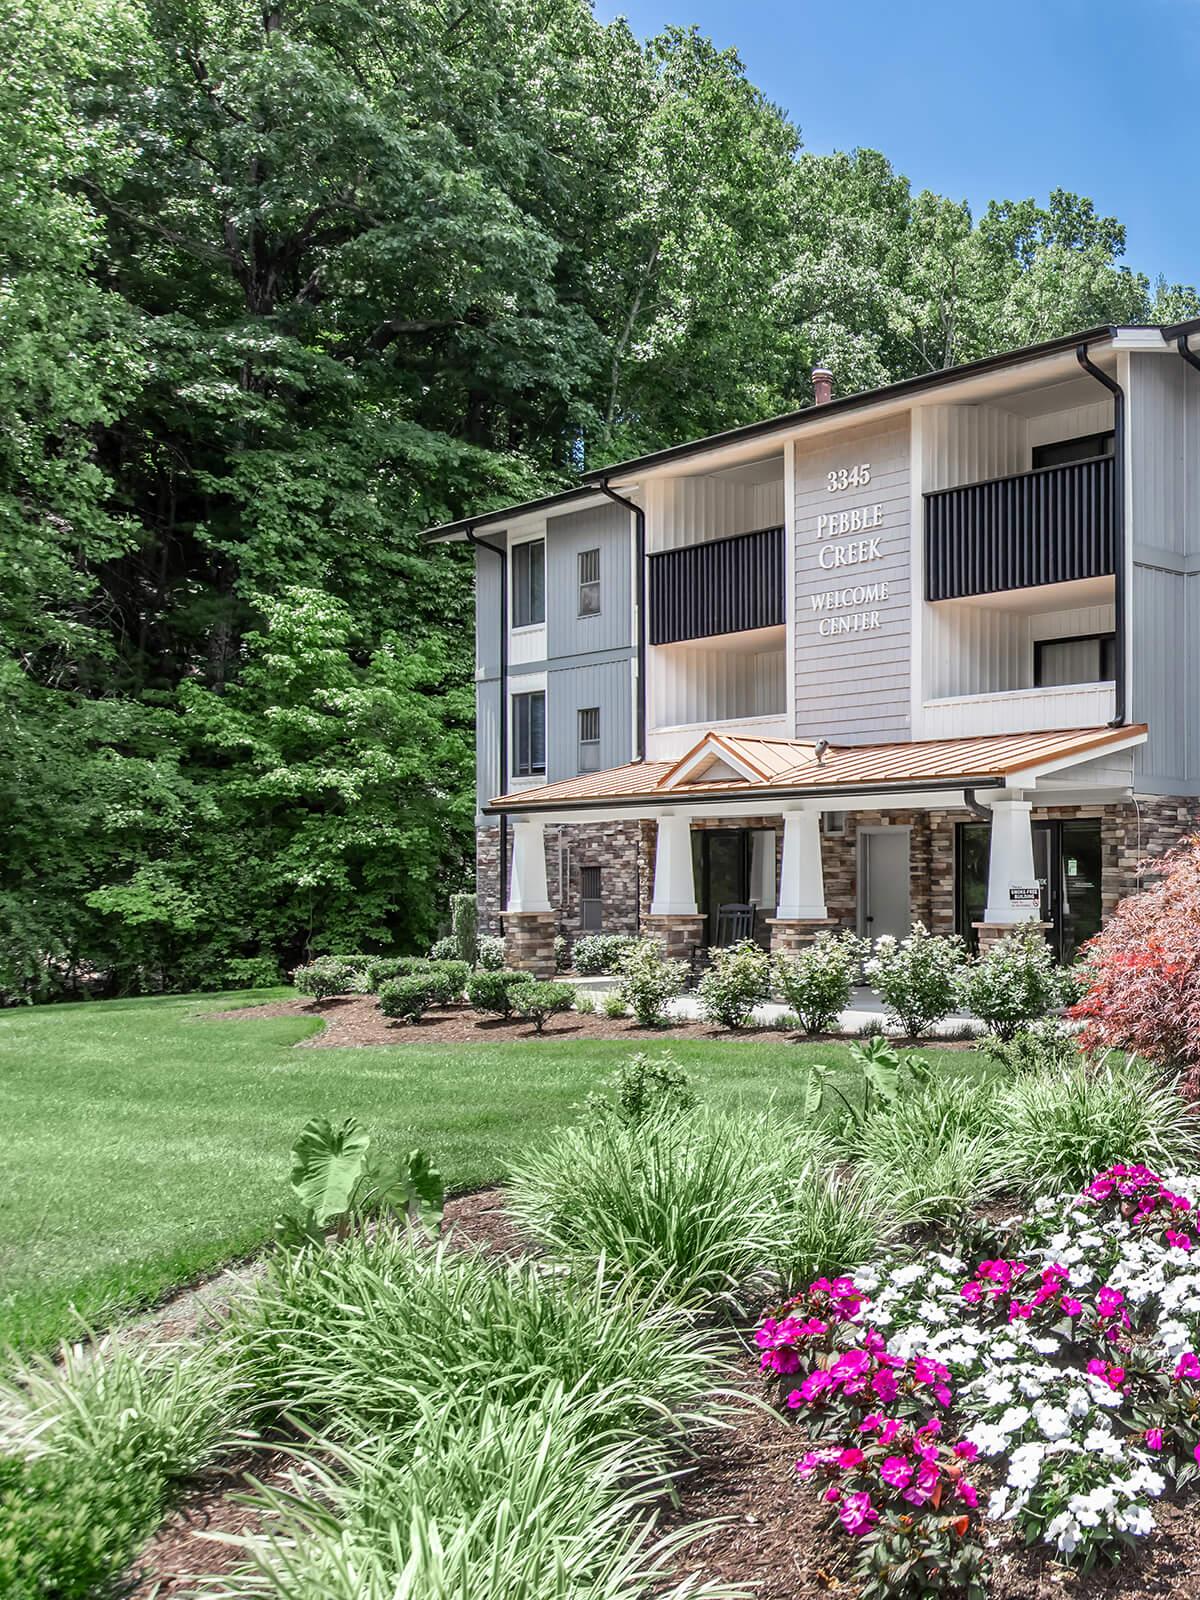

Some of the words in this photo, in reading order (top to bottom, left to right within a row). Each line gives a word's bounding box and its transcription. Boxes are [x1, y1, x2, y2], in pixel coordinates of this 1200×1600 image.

[827, 463, 871, 492] 3345
[817, 504, 883, 539] PEBBLE
[819, 537, 883, 569] CREEK
[811, 582, 889, 612] WELCOME
[819, 611, 881, 636] CENTER
